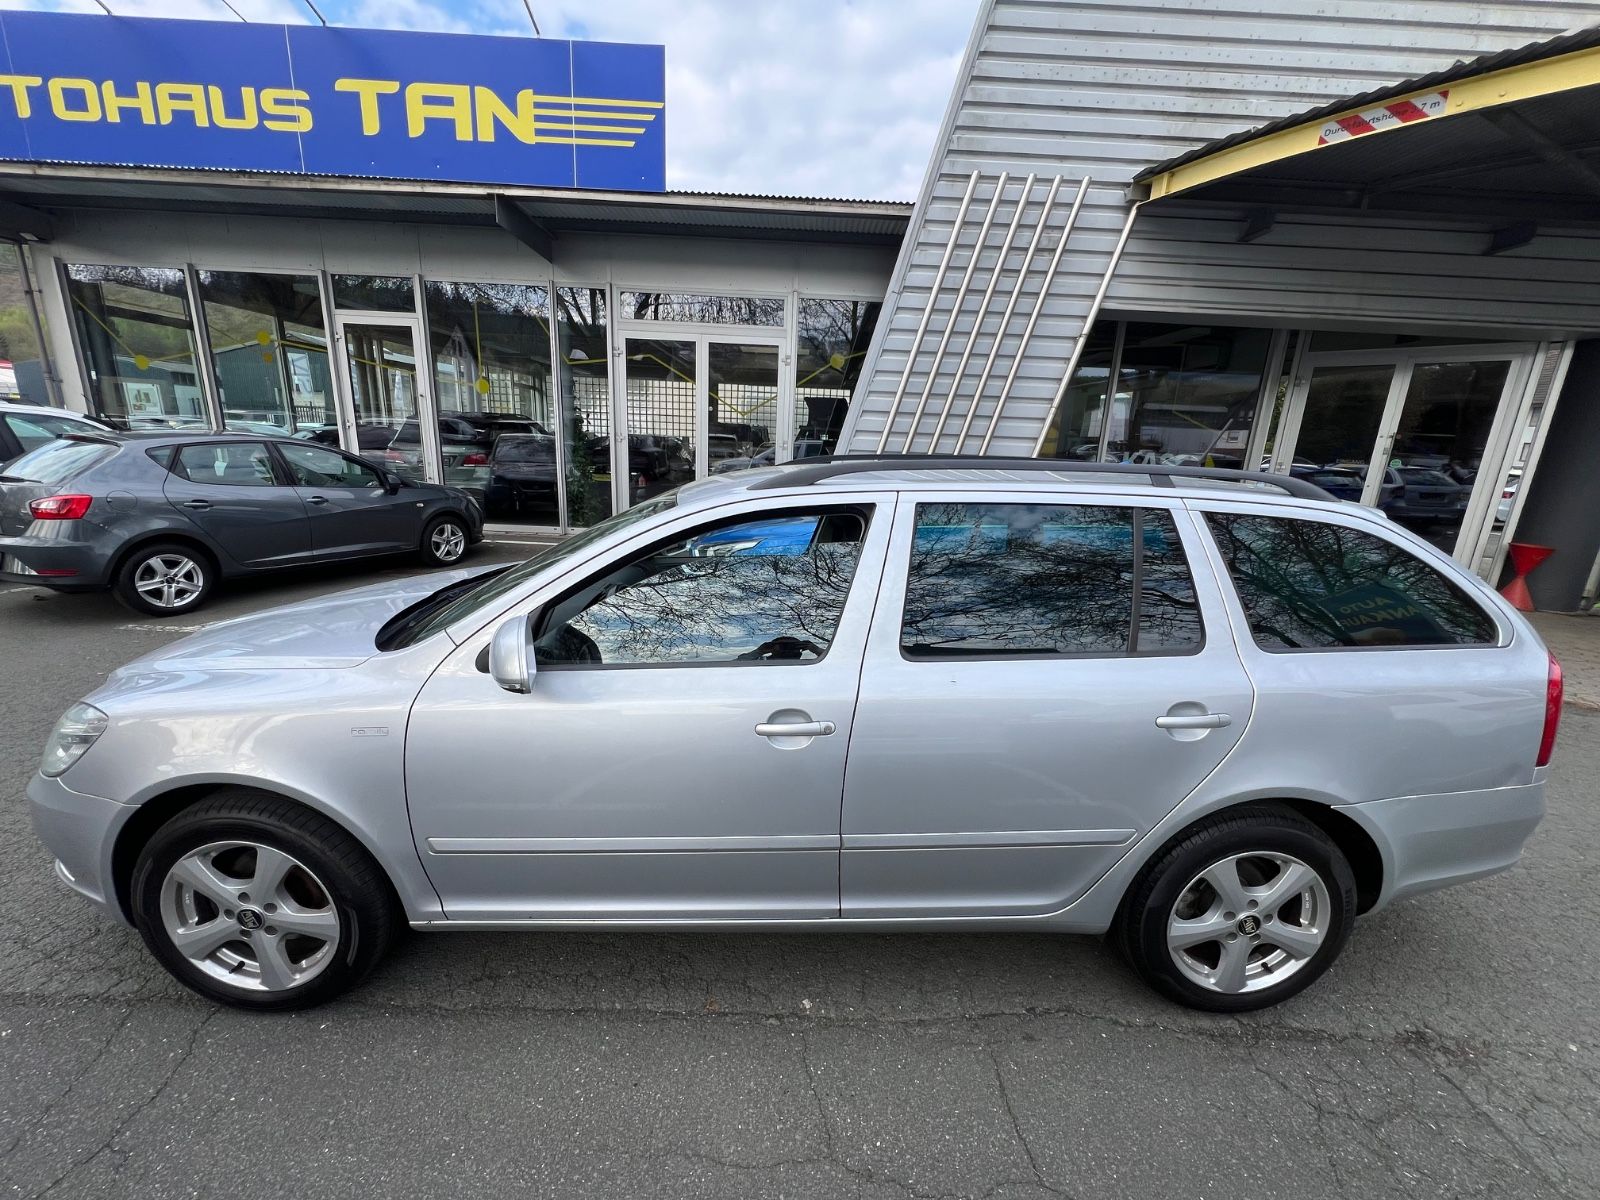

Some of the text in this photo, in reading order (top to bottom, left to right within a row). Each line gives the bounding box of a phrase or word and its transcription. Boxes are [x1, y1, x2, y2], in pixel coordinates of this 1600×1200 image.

[0, 75, 536, 144] TOHAUS TAN
[1429, 101, 1441, 109] m
